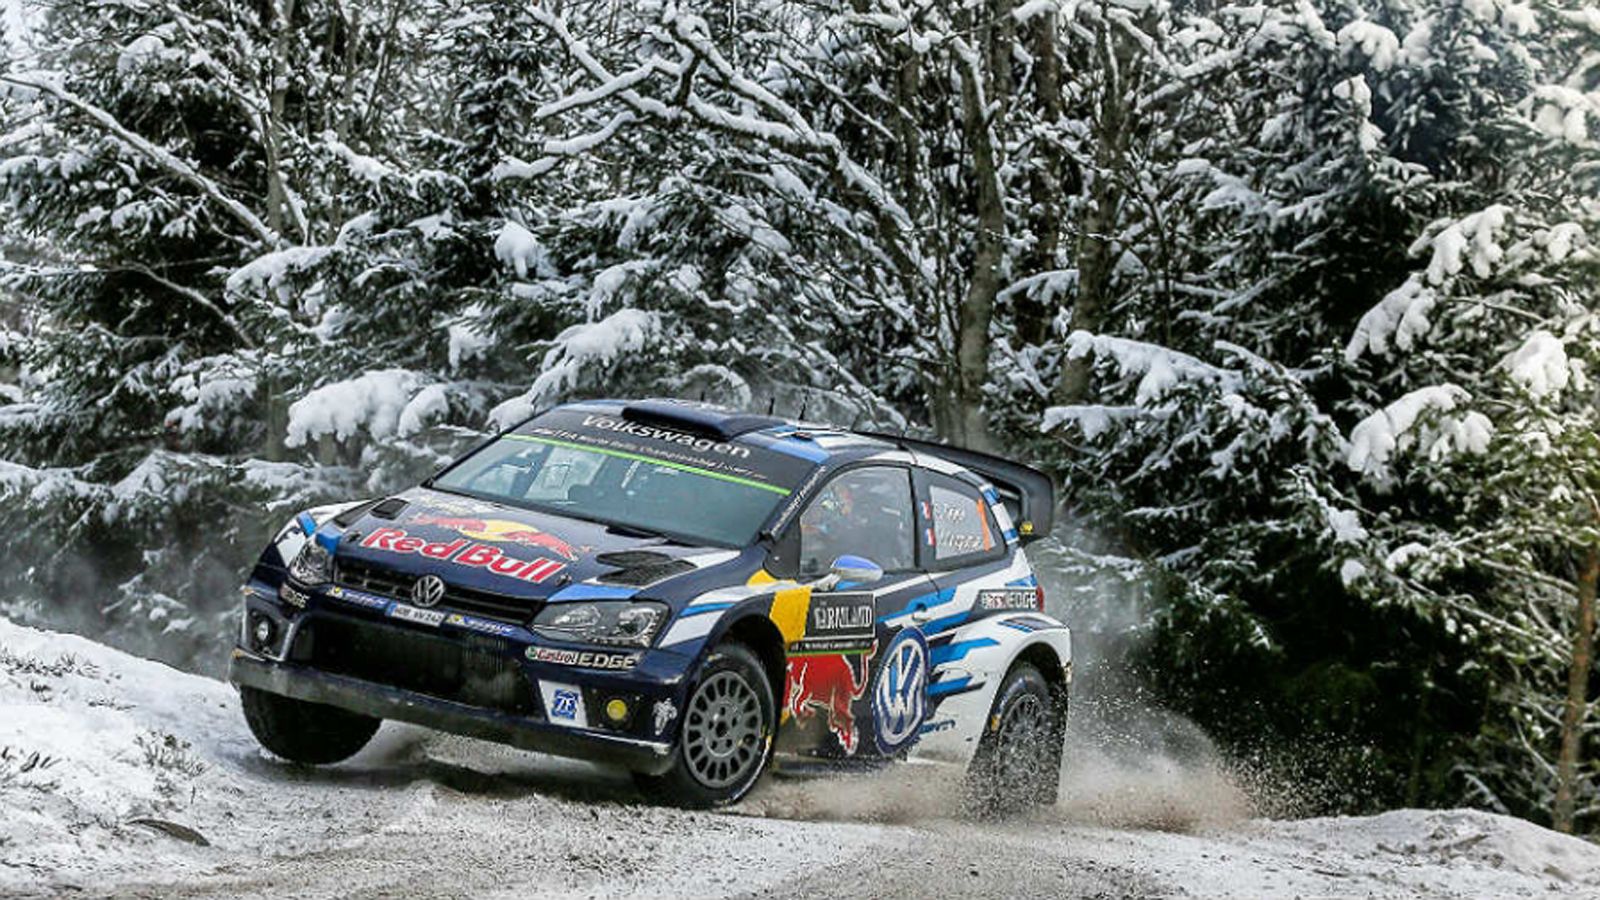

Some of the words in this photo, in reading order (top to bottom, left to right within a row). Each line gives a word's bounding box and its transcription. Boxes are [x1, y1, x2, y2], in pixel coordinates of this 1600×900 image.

[582, 415, 751, 459] Volkswagen
[360, 527, 469, 560] Red
[452, 542, 567, 583] Bull
[1008, 592, 1037, 609] EDGE
[537, 649, 575, 663] Castrol
[576, 653, 638, 670] EDGE
